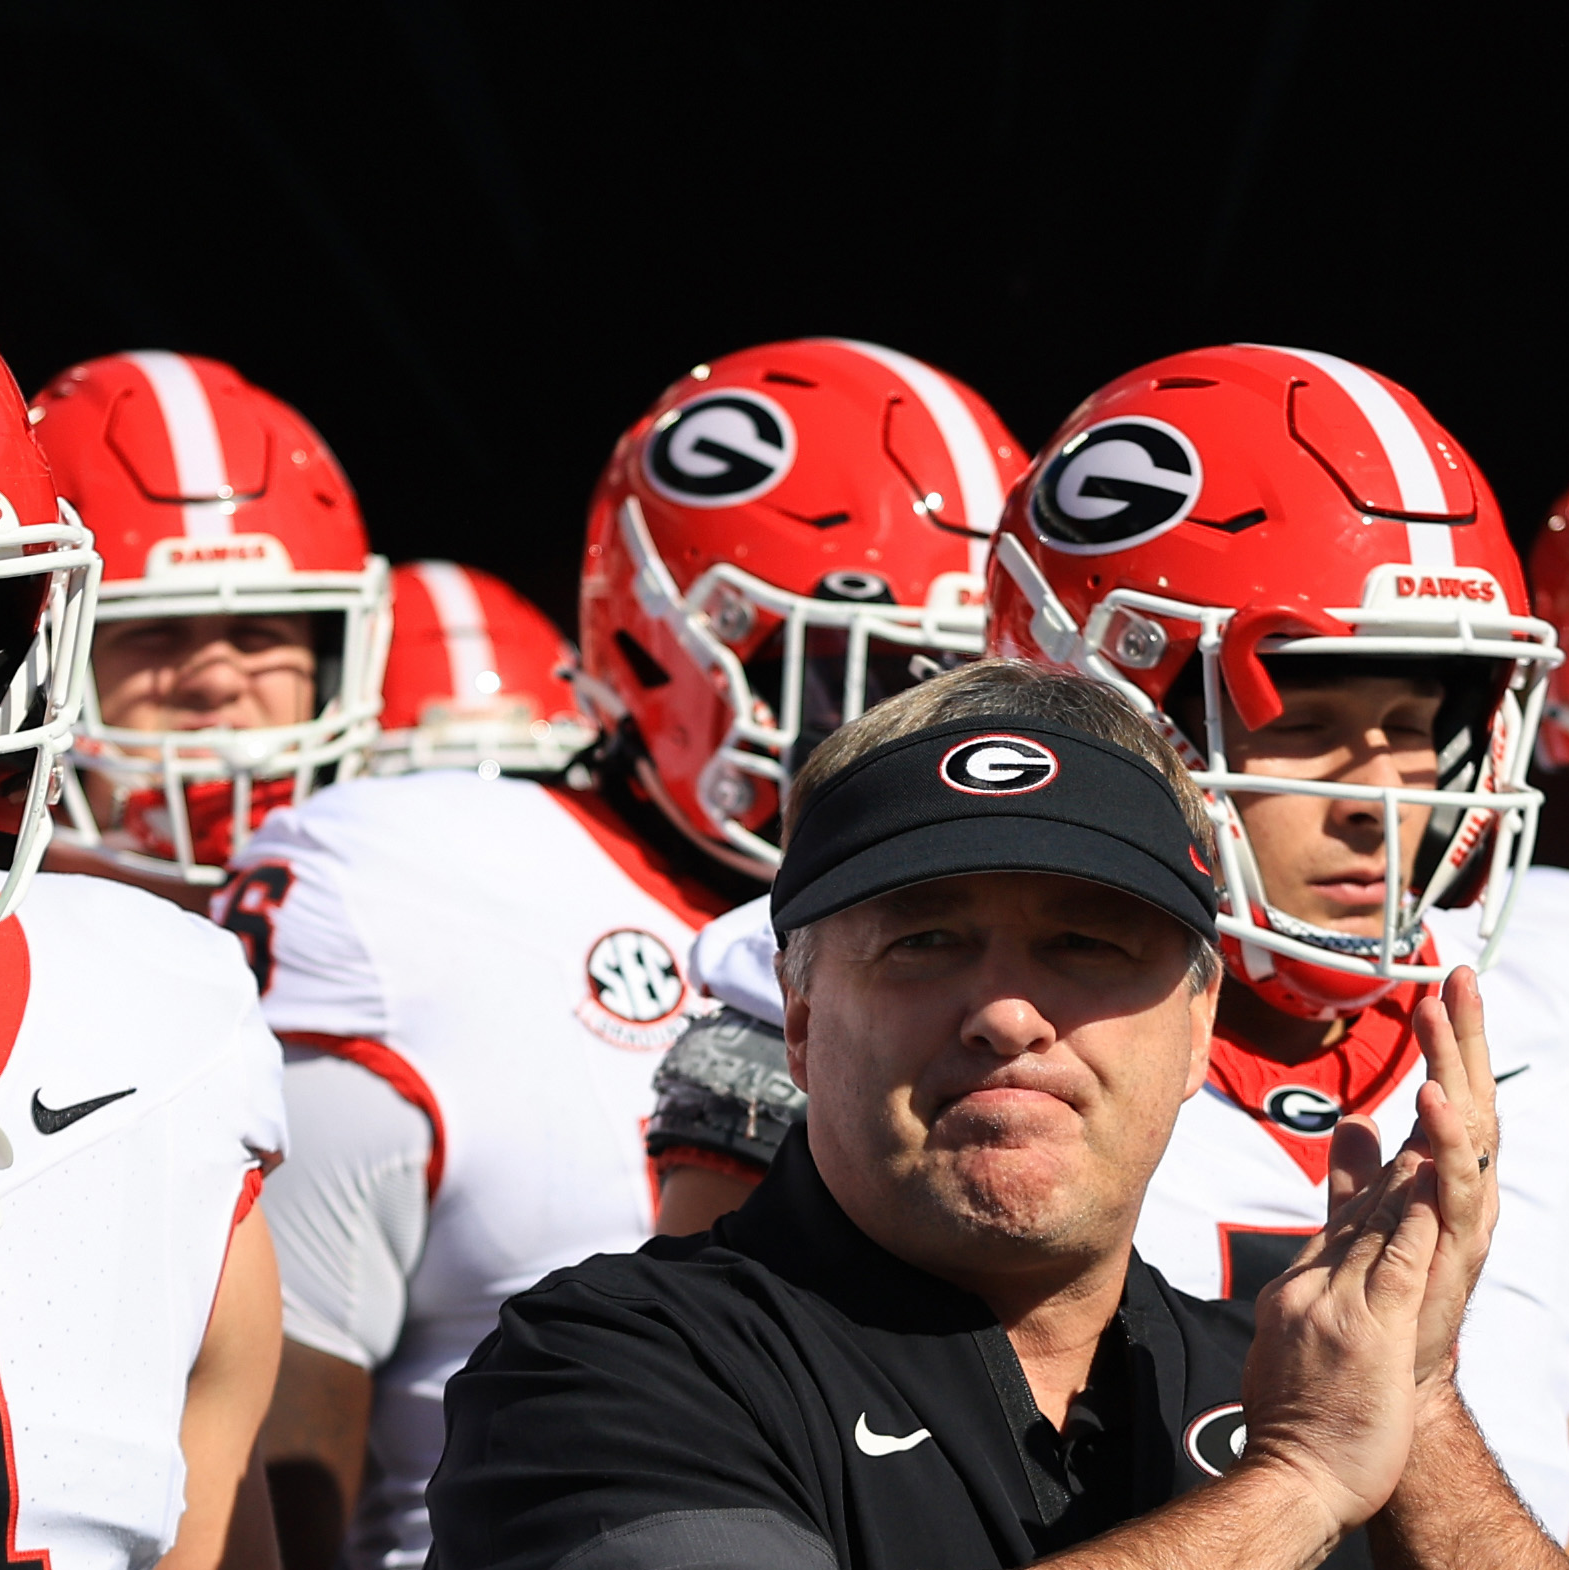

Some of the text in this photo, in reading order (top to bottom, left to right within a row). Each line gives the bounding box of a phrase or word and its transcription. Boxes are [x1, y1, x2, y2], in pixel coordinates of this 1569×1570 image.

[650, 395, 785, 496] G
[1031, 423, 1193, 545] G
[1395, 577, 1495, 603] DAWGS
[945, 739, 1052, 791] G
[587, 929, 683, 1022] SEC
[1270, 1090, 1340, 1132] G
